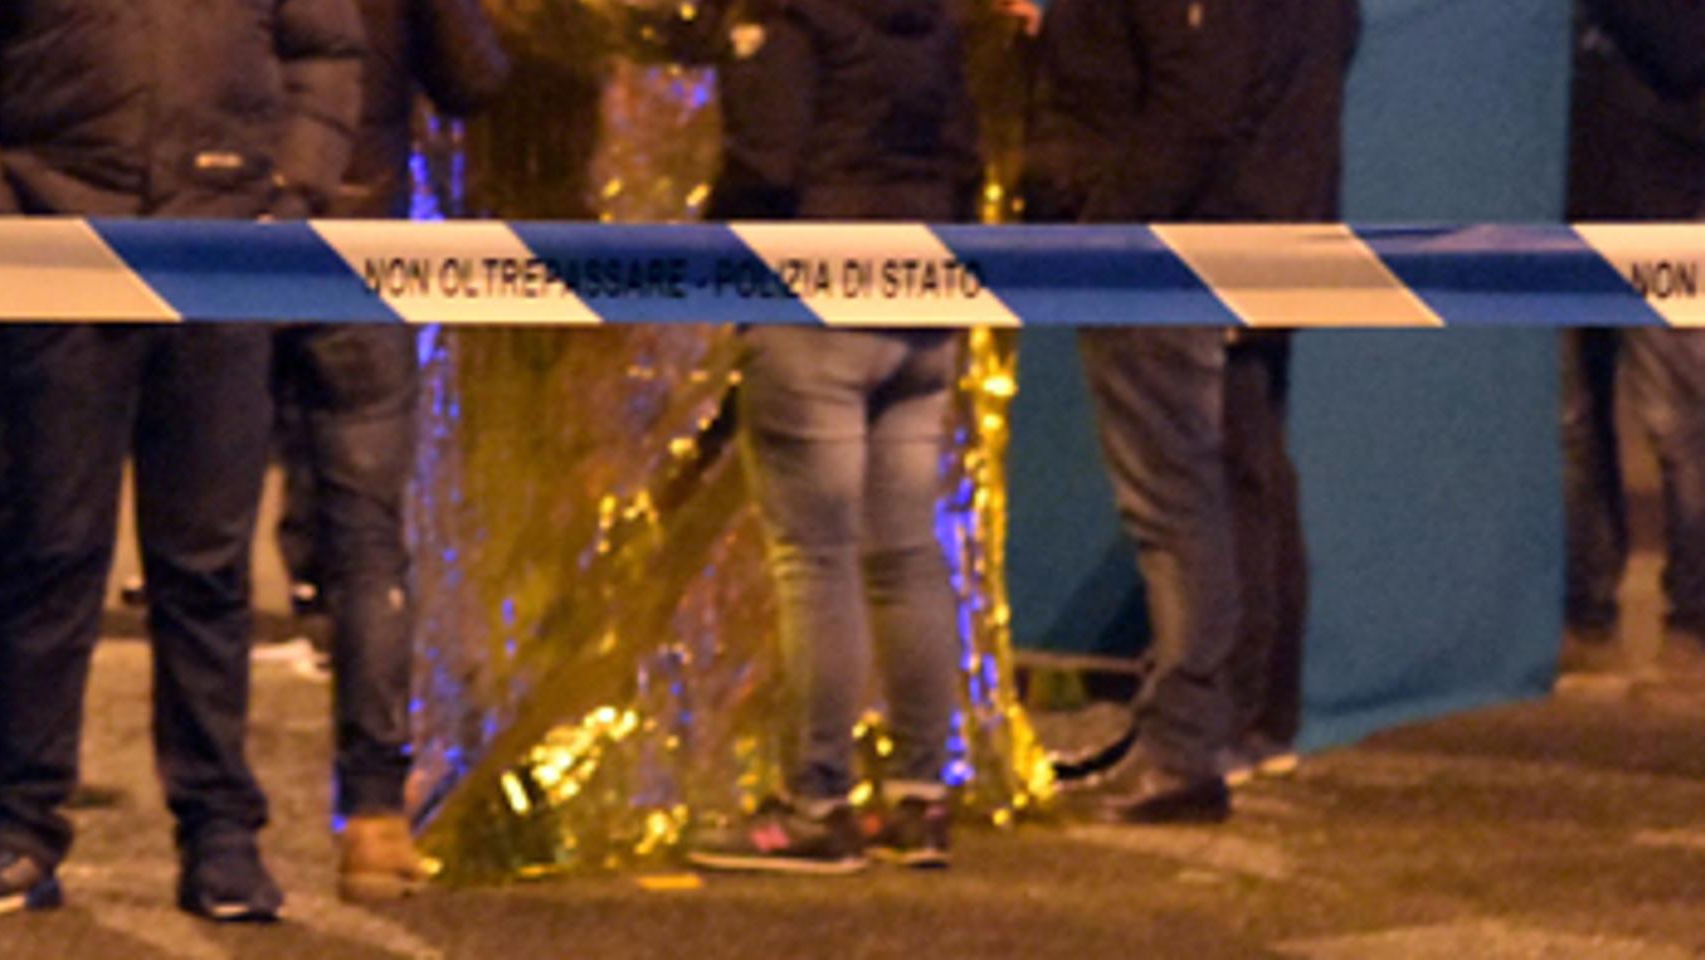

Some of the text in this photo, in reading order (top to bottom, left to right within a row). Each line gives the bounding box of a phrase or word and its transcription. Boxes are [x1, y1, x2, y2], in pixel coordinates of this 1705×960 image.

[364, 257, 430, 297] NON
[438, 257, 687, 299] OLTREPASSARE
[715, 258, 832, 299] POLIZIA
[843, 258, 873, 299] DI
[881, 258, 981, 299] STATO
[1631, 260, 1697, 300] NON
